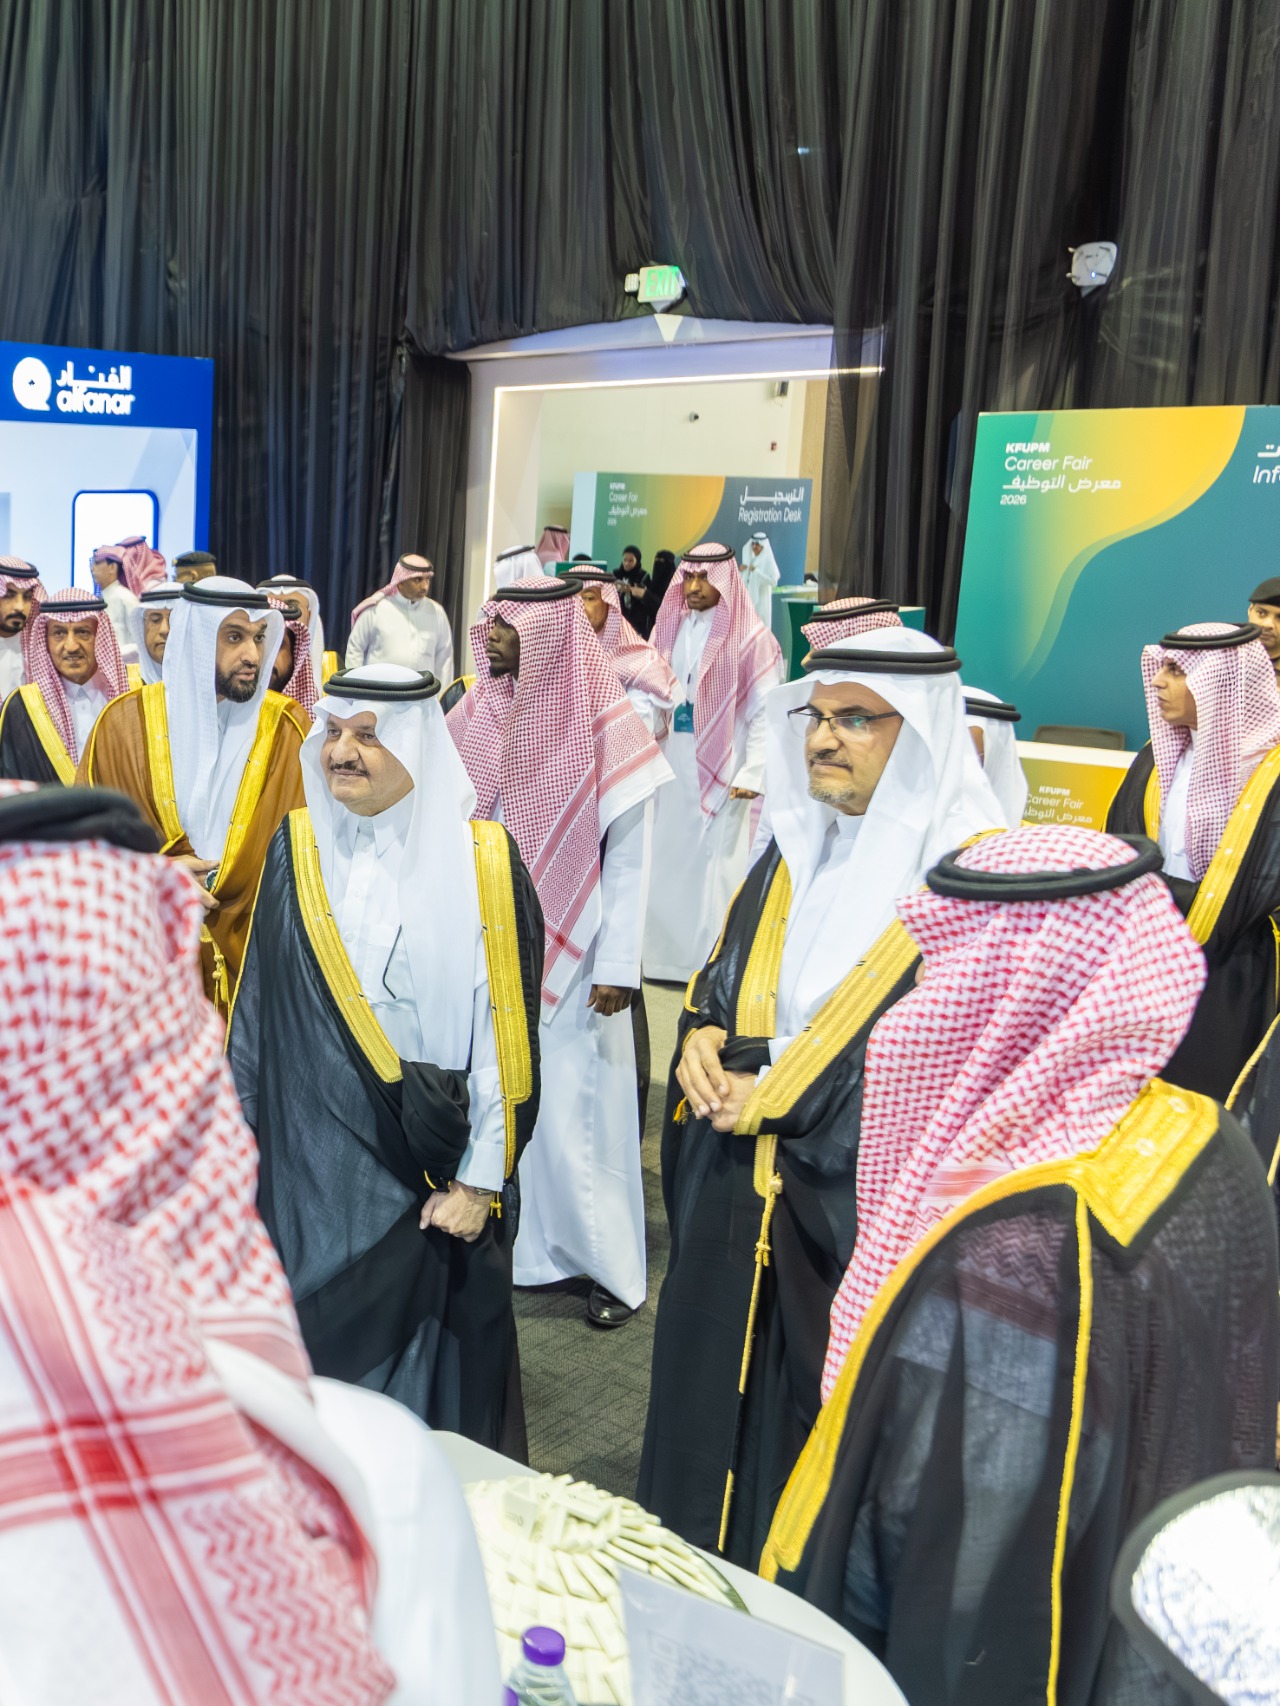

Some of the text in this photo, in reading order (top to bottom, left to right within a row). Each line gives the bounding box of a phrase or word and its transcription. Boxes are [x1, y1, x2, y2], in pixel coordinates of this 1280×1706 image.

[645, 268, 679, 297] EXIT
[56, 361, 132, 390] الفنار
[56, 384, 135, 415] alfanar
[1005, 442, 1051, 453] KFUPM
[1005, 455, 1093, 471] Career Fair
[1002, 474, 1121, 493] معرض التوظيف
[740, 485, 805, 506] التسجيل
[1000, 494, 1027, 505] 2026
[738, 506, 802, 527] Registration Desk
[1038, 786, 1071, 796] KFUPM
[1063, 797, 1085, 809] Fair
[1056, 813, 1093, 824] معرض
